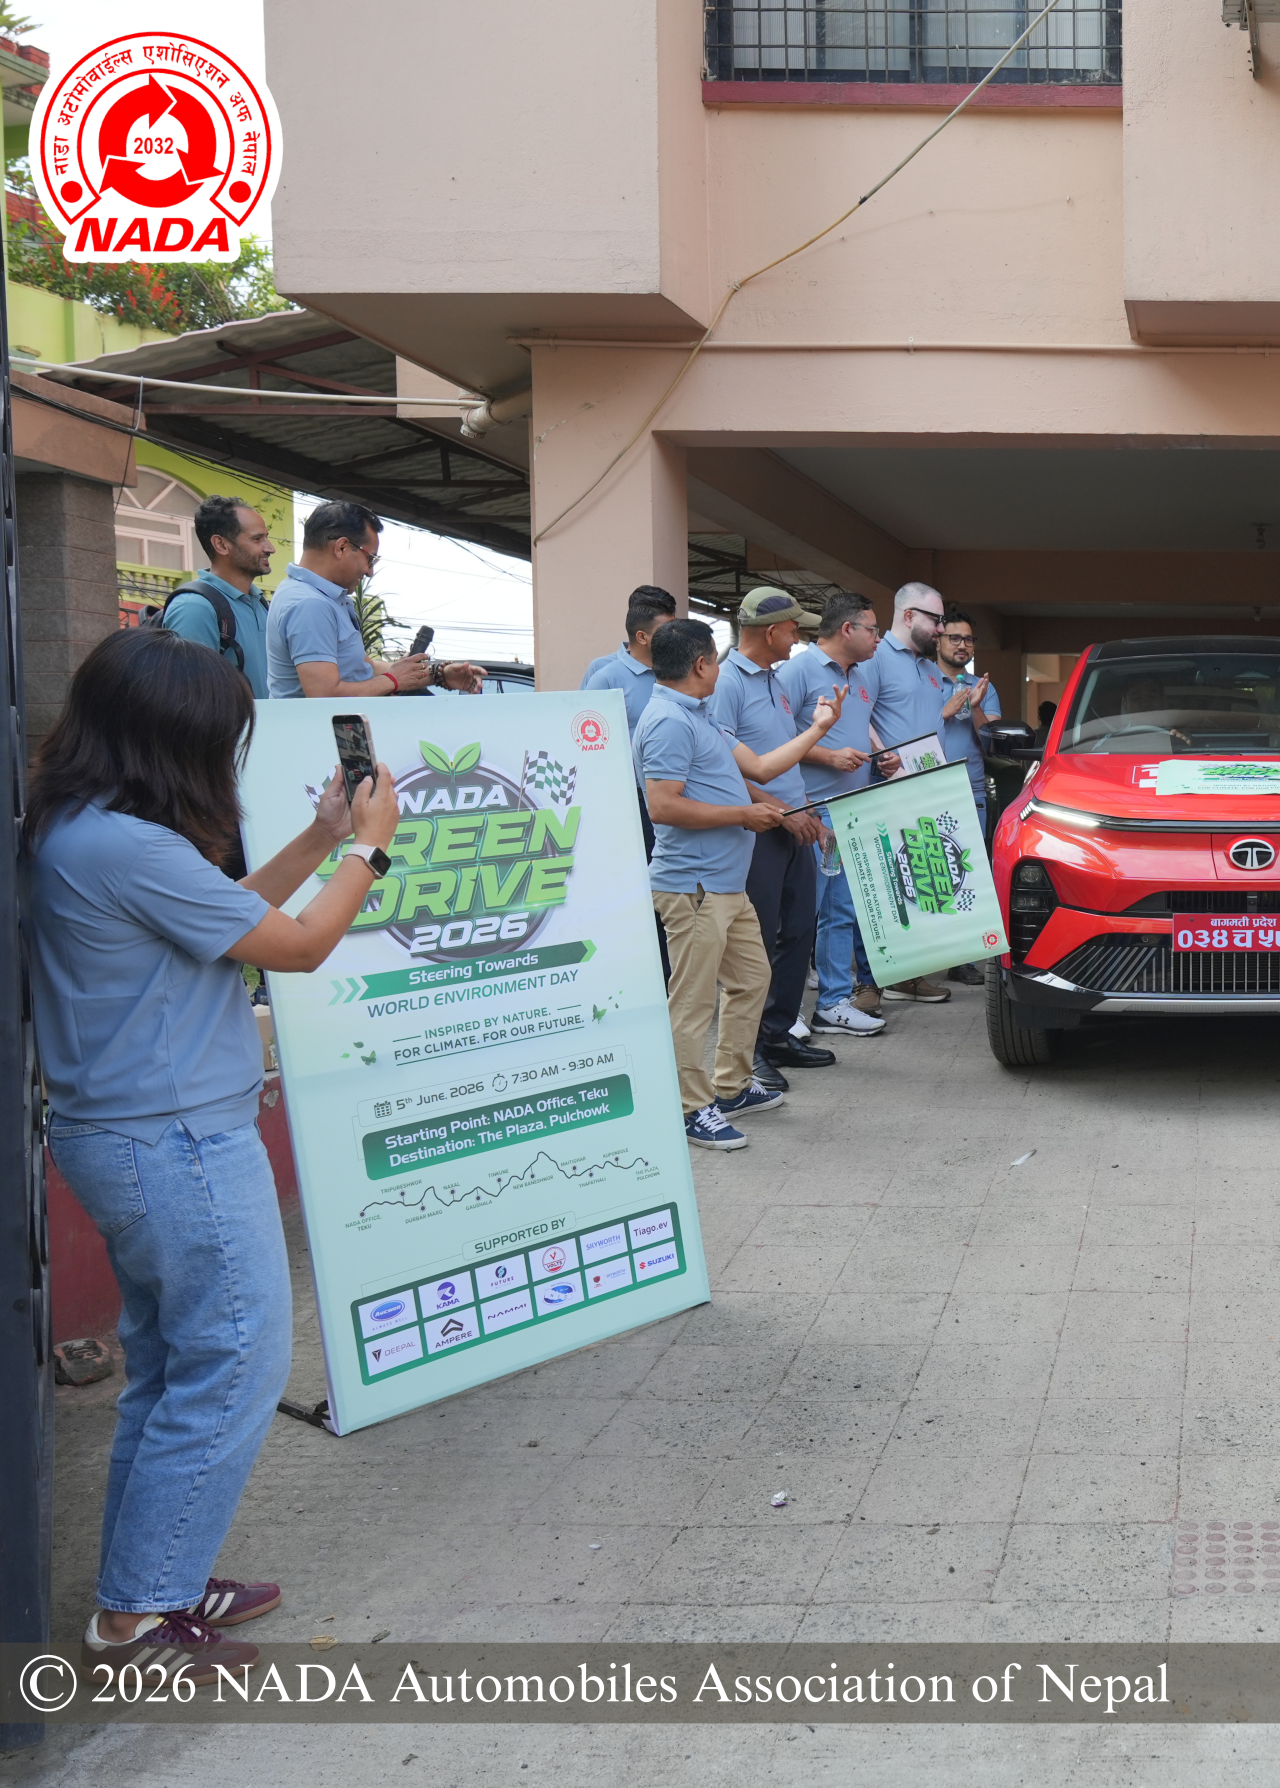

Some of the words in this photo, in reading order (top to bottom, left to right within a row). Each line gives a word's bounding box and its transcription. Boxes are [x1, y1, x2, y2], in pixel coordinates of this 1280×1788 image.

[398, 785, 509, 815] NADA
[897, 853, 916, 898] 2026
[901, 828, 940, 914] DRIVE
[919, 816, 958, 915] GREEN
[943, 841, 960, 885] NADA
[351, 855, 575, 927] DRIVE
[409, 912, 529, 953] 2026
[1210, 916, 1250, 927] बागमती
[1252, 916, 1277, 928] प्रदेश
[409, 965, 472, 985] Steering
[476, 953, 539, 974] Towards
[367, 996, 429, 1018] WORLD
[434, 975, 546, 1006] ENVIRONMENT
[550, 970, 578, 986] DAY
[394, 1047, 420, 1060] FOR
[424, 1035, 480, 1054] CLIMATE.
[483, 1030, 507, 1043] FOR
[510, 1025, 535, 1037] OUR
[538, 1014, 585, 1032] FUTURE.
[425, 1021, 480, 1039] INSPIRED
[484, 1017, 499, 1028] BY
[503, 1007, 551, 1024] NATURE.
[512, 1070, 538, 1085] 7:30
[540, 1065, 559, 1077] AM
[568, 1057, 594, 1072] 9:30
[596, 1053, 614, 1065] AM
[396, 1096, 413, 1110] 5th
[450, 1081, 485, 1098] 2026
[385, 1124, 447, 1150] Starting
[451, 1115, 491, 1134] Point:
[493, 1104, 535, 1123] NADA
[578, 1087, 609, 1102] Teku
[389, 1136, 476, 1168] Destination:
[478, 1130, 503, 1144] The
[549, 1103, 610, 1127] Pulchowk
[474, 1223, 549, 1254] SUPPORTED
[551, 1217, 566, 1231] BY
[586, 1234, 621, 1251] SKYWORTH
[634, 1221, 668, 1238] Tiago.ev
[546, 1259, 563, 1268] VOLTS
[647, 1253, 675, 1267] SUZUKI
[491, 1276, 515, 1287] FUTURE
[436, 1298, 460, 1310] KAMA
[488, 1303, 527, 1320] NAMMI
[384, 1341, 416, 1357] DEEPAL
[435, 1330, 473, 1348] AMPERE
